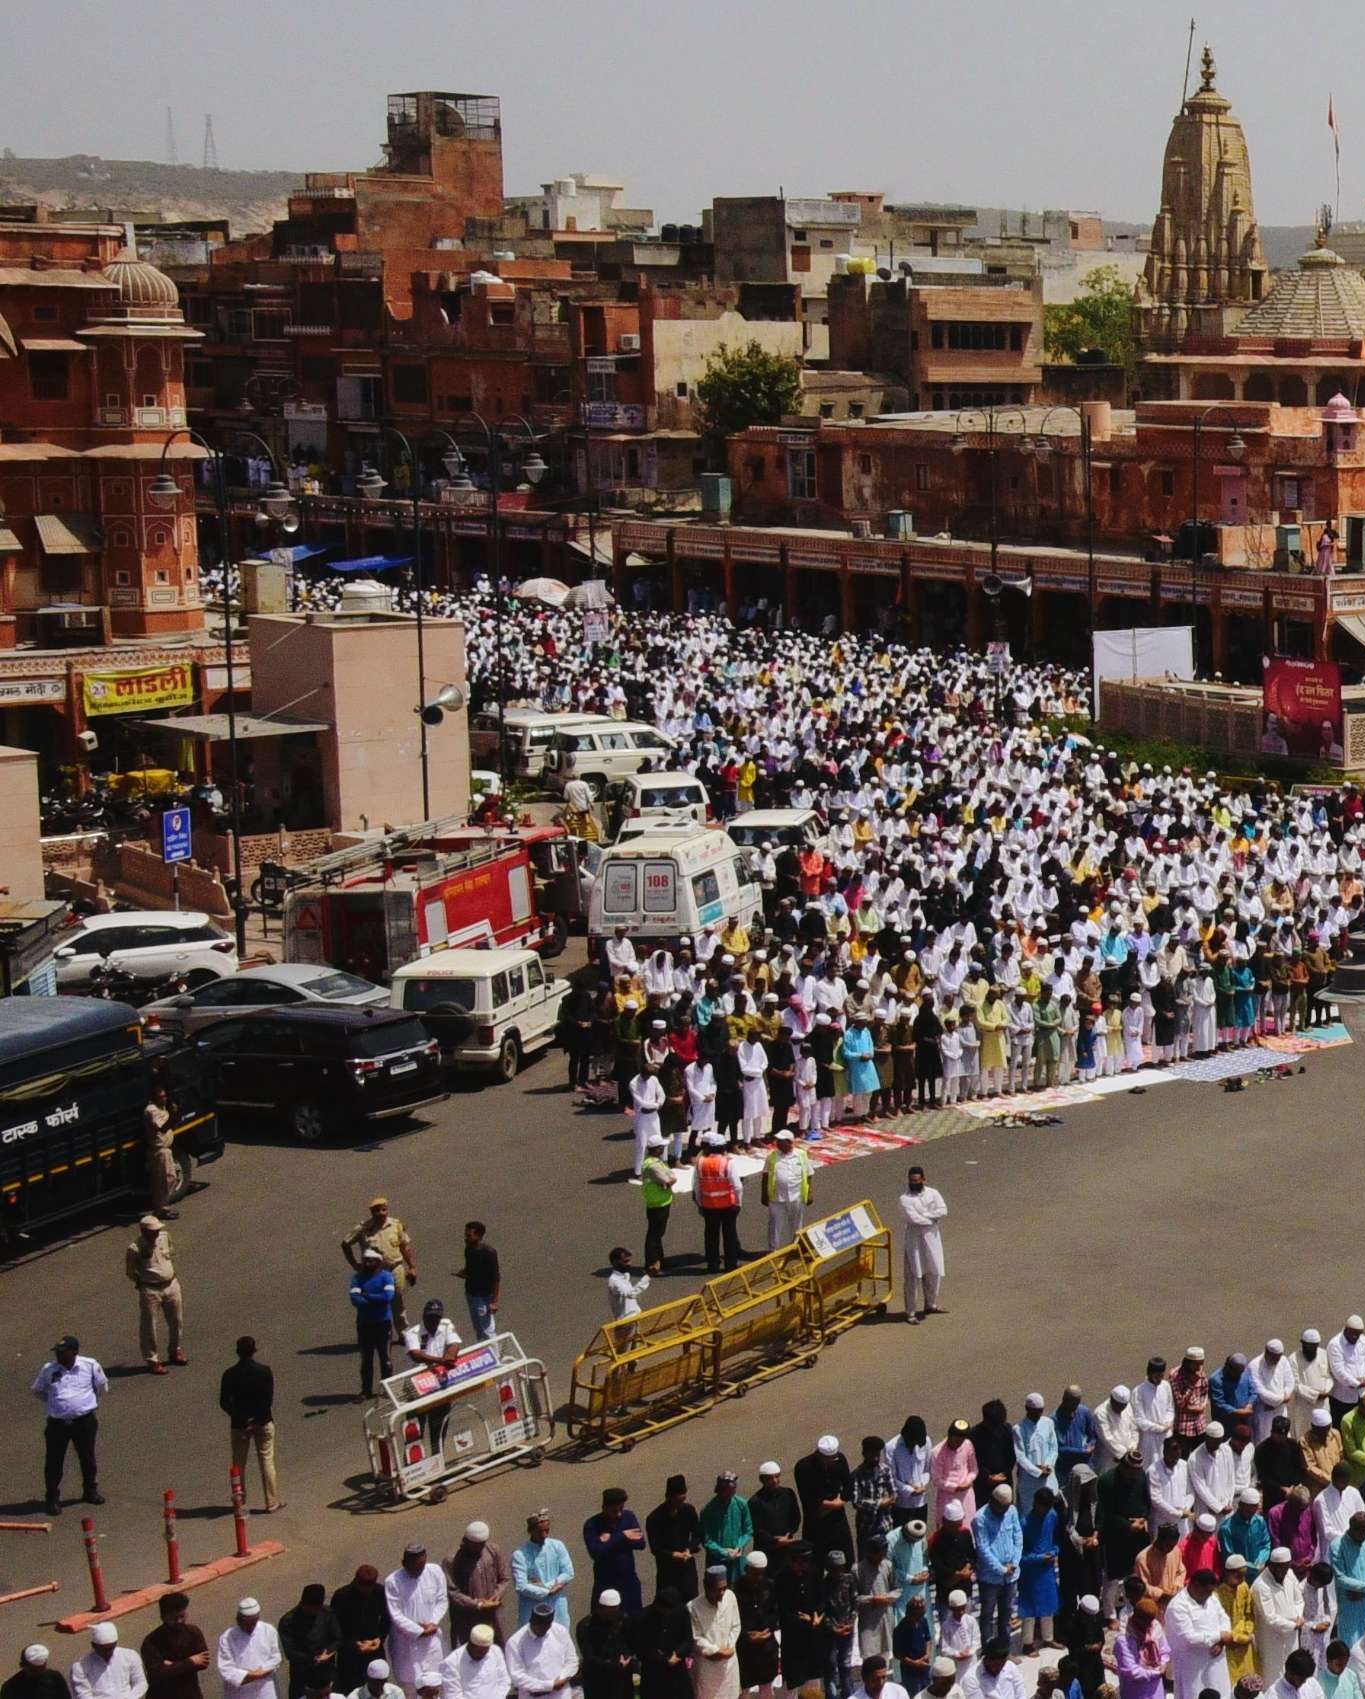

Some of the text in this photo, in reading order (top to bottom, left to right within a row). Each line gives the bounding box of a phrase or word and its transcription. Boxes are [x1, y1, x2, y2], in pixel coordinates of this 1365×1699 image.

[114, 666, 187, 697] लाडली
[647, 875, 669, 888] 108
[1, 1101, 80, 1144] टास्क फोर्स
